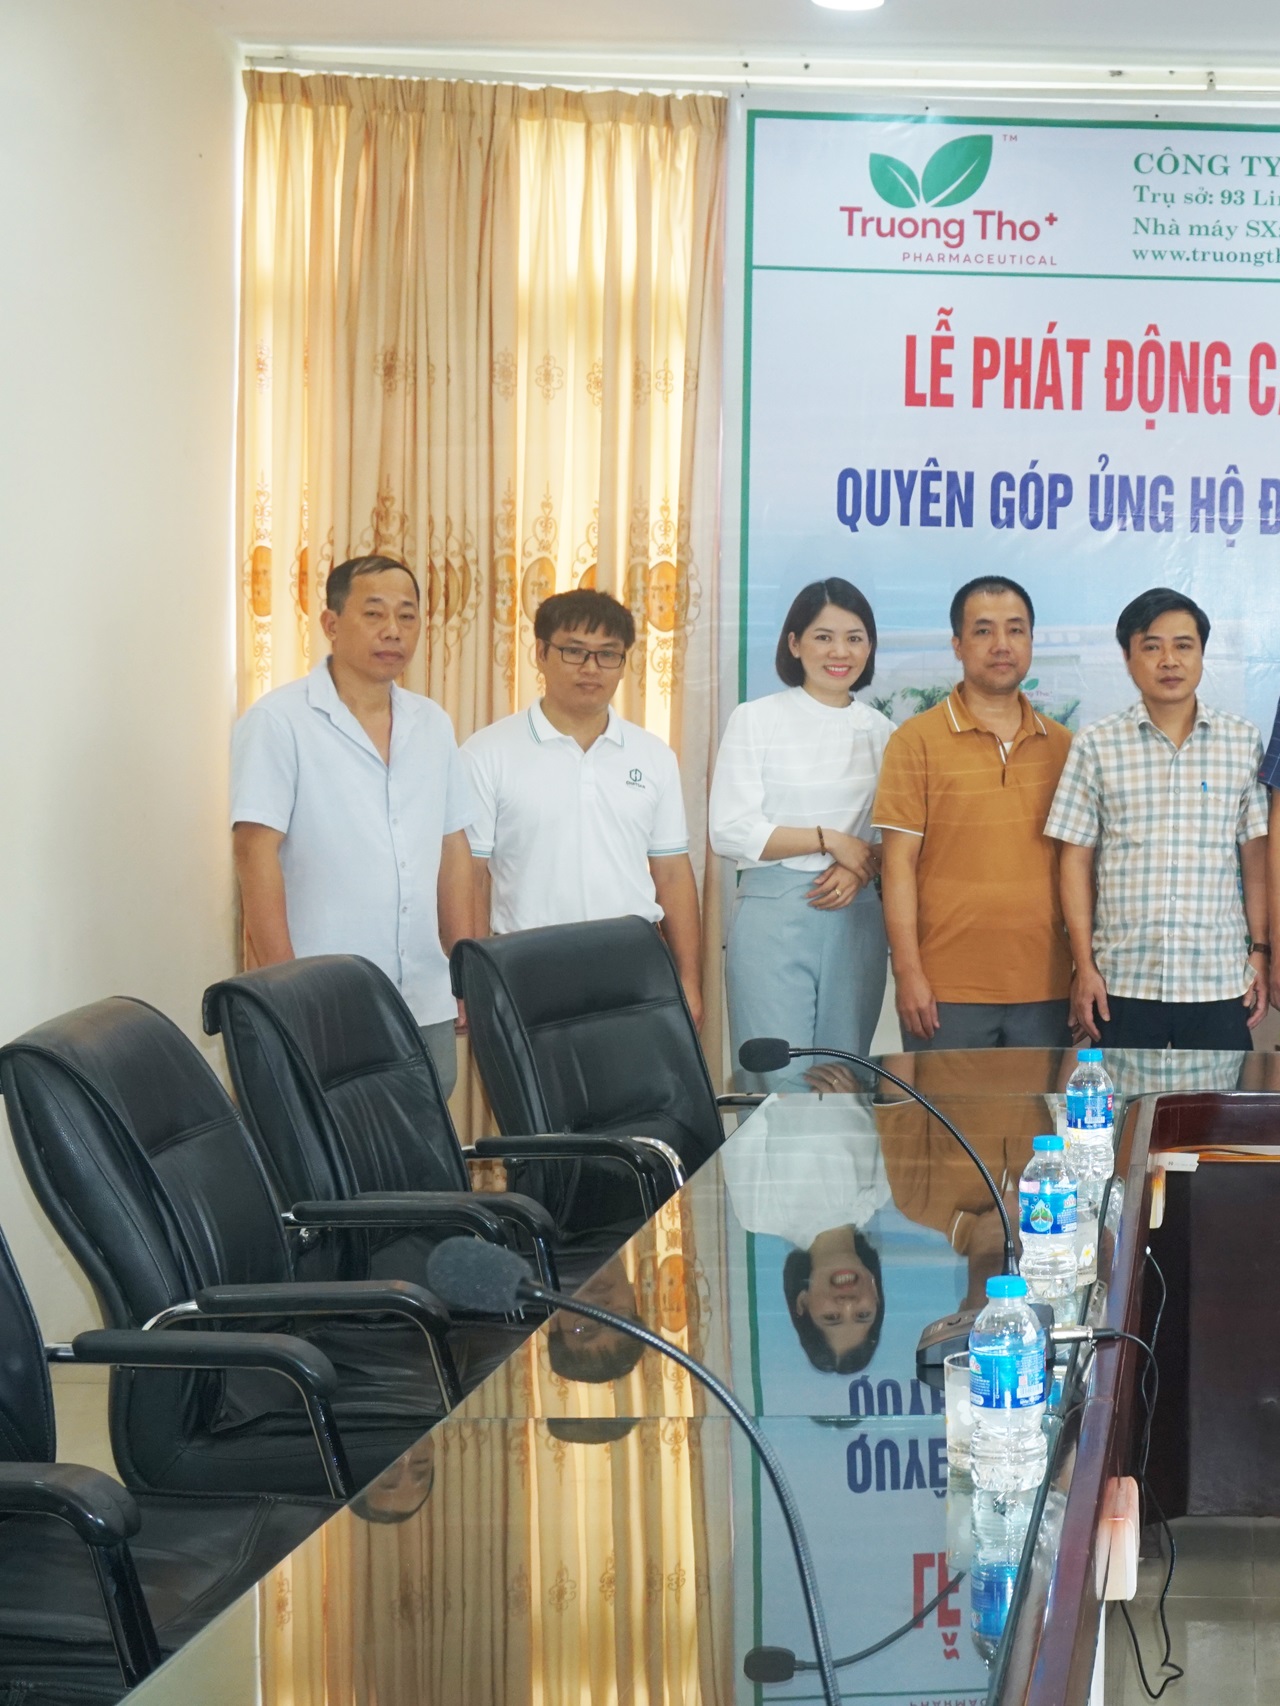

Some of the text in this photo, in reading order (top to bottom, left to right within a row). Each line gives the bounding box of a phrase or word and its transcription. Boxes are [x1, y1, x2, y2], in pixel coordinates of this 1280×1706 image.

[1134, 147, 1230, 175] CÔNG
[1133, 185, 1175, 208] Trụ
[1184, 187, 1213, 204] sở:
[1220, 189, 1245, 205] 93
[840, 206, 964, 249] Truong
[1133, 217, 1180, 235] Nhà
[1189, 220, 1237, 240] máy
[902, 252, 1058, 266] PHARMACEUTICAL
[905, 307, 954, 408] LỄ
[972, 322, 1090, 410] PHÁT
[1104, 324, 1231, 430] ĐỘNG
[837, 458, 974, 532] QUYÊN
[990, 460, 1073, 530] GÓP
[1089, 454, 1174, 533] ỦNG
[1190, 464, 1244, 547] HỘ
